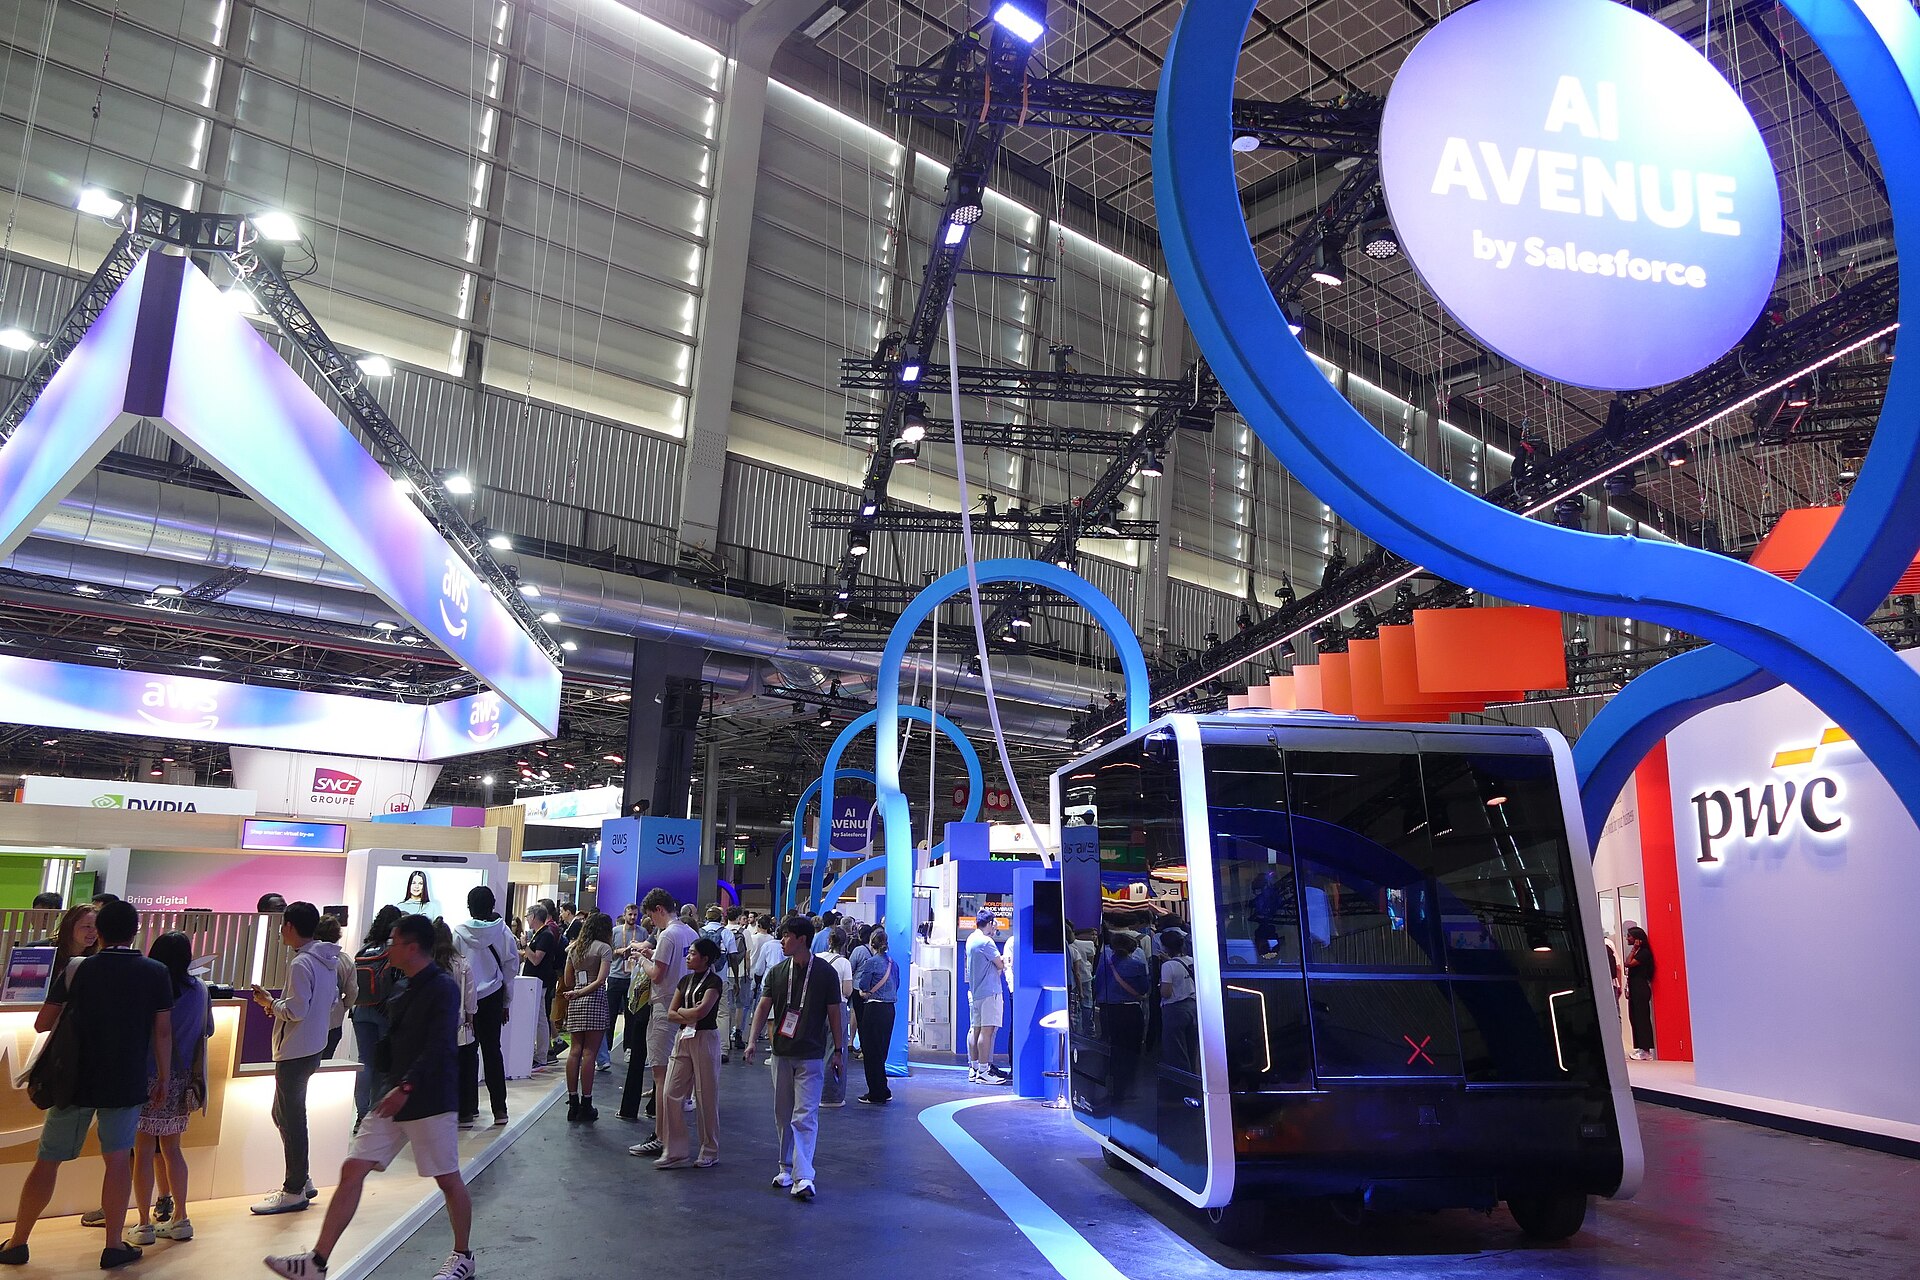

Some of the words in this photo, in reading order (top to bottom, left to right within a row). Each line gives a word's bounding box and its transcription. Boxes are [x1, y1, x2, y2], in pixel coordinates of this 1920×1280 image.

[1544, 75, 1619, 141] AI
[1430, 137, 1741, 236] AVENUE
[1473, 229, 1517, 269] by
[1524, 237, 1707, 288] Salesforce
[442, 560, 470, 613] aws
[142, 681, 218, 713] aws
[470, 700, 500, 725] aws
[314, 778, 360, 792] SNCF
[127, 798, 197, 813] NVIDIA
[310, 795, 355, 805] GROUPE
[844, 808, 856, 817] AI
[1691, 777, 1841, 862] pwc
[612, 833, 628, 845] aws
[657, 833, 684, 846] aws
[127, 896, 153, 905] Bring
[155, 896, 188, 906] digital
